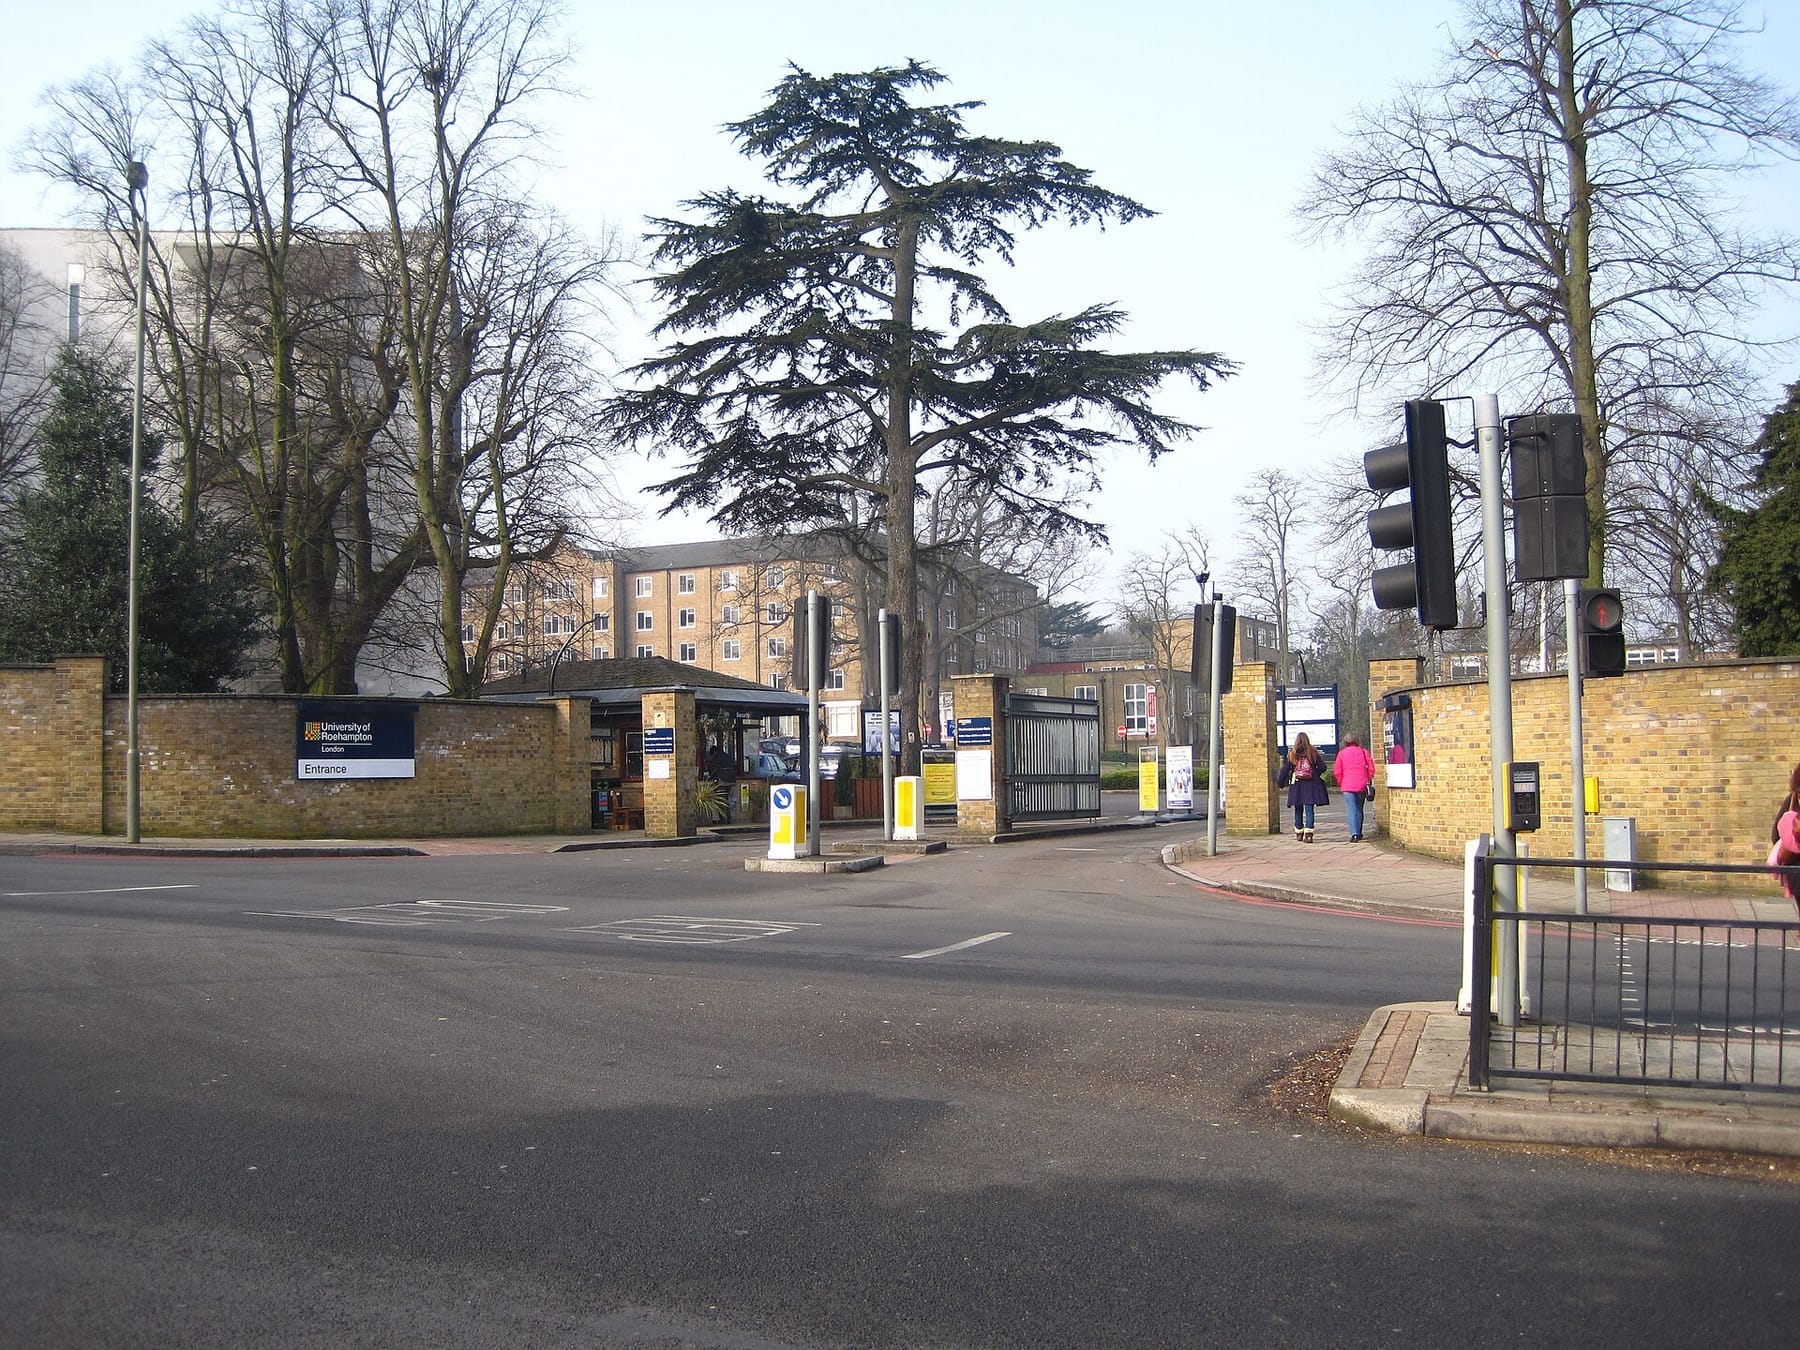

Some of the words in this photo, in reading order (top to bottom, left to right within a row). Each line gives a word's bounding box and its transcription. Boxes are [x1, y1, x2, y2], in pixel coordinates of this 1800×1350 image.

[321, 722, 361, 733] University
[362, 722, 371, 731] of
[321, 732, 373, 742] Roehampton
[304, 764, 347, 774] Entrance
[241, 898, 571, 926] CLEAR
[552, 914, 823, 944] KEEP
